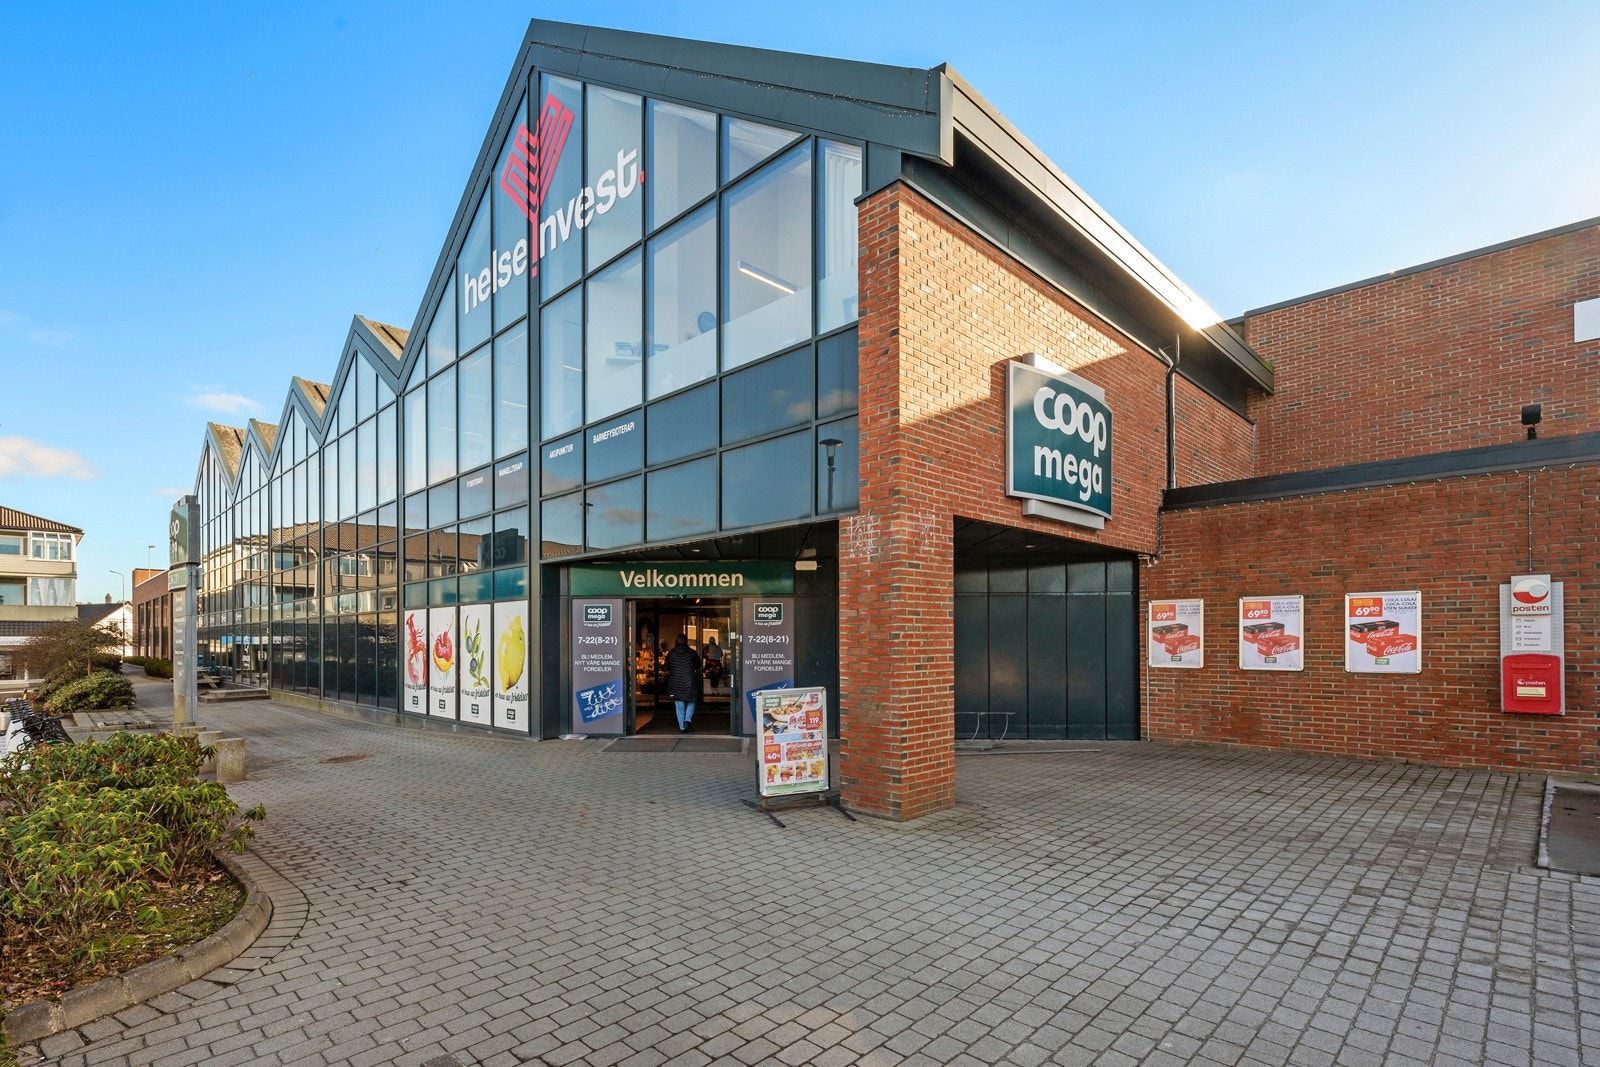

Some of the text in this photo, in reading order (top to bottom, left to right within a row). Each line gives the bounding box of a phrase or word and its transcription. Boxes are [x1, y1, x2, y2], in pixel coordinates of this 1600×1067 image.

[464, 238, 528, 314] helse
[1034, 386, 1107, 457] coop
[593, 421, 635, 444] BARNEFYSIOTERAPI
[549, 443, 574, 459] AKUPUNKTUR
[1034, 445, 1103, 501] mega
[619, 569, 744, 588] Velkommen
[1513, 604, 1550, 613] posten
[577, 636, 618, 645] 7-22(8-21)
[748, 635, 789, 644] 7-22(8-21)
